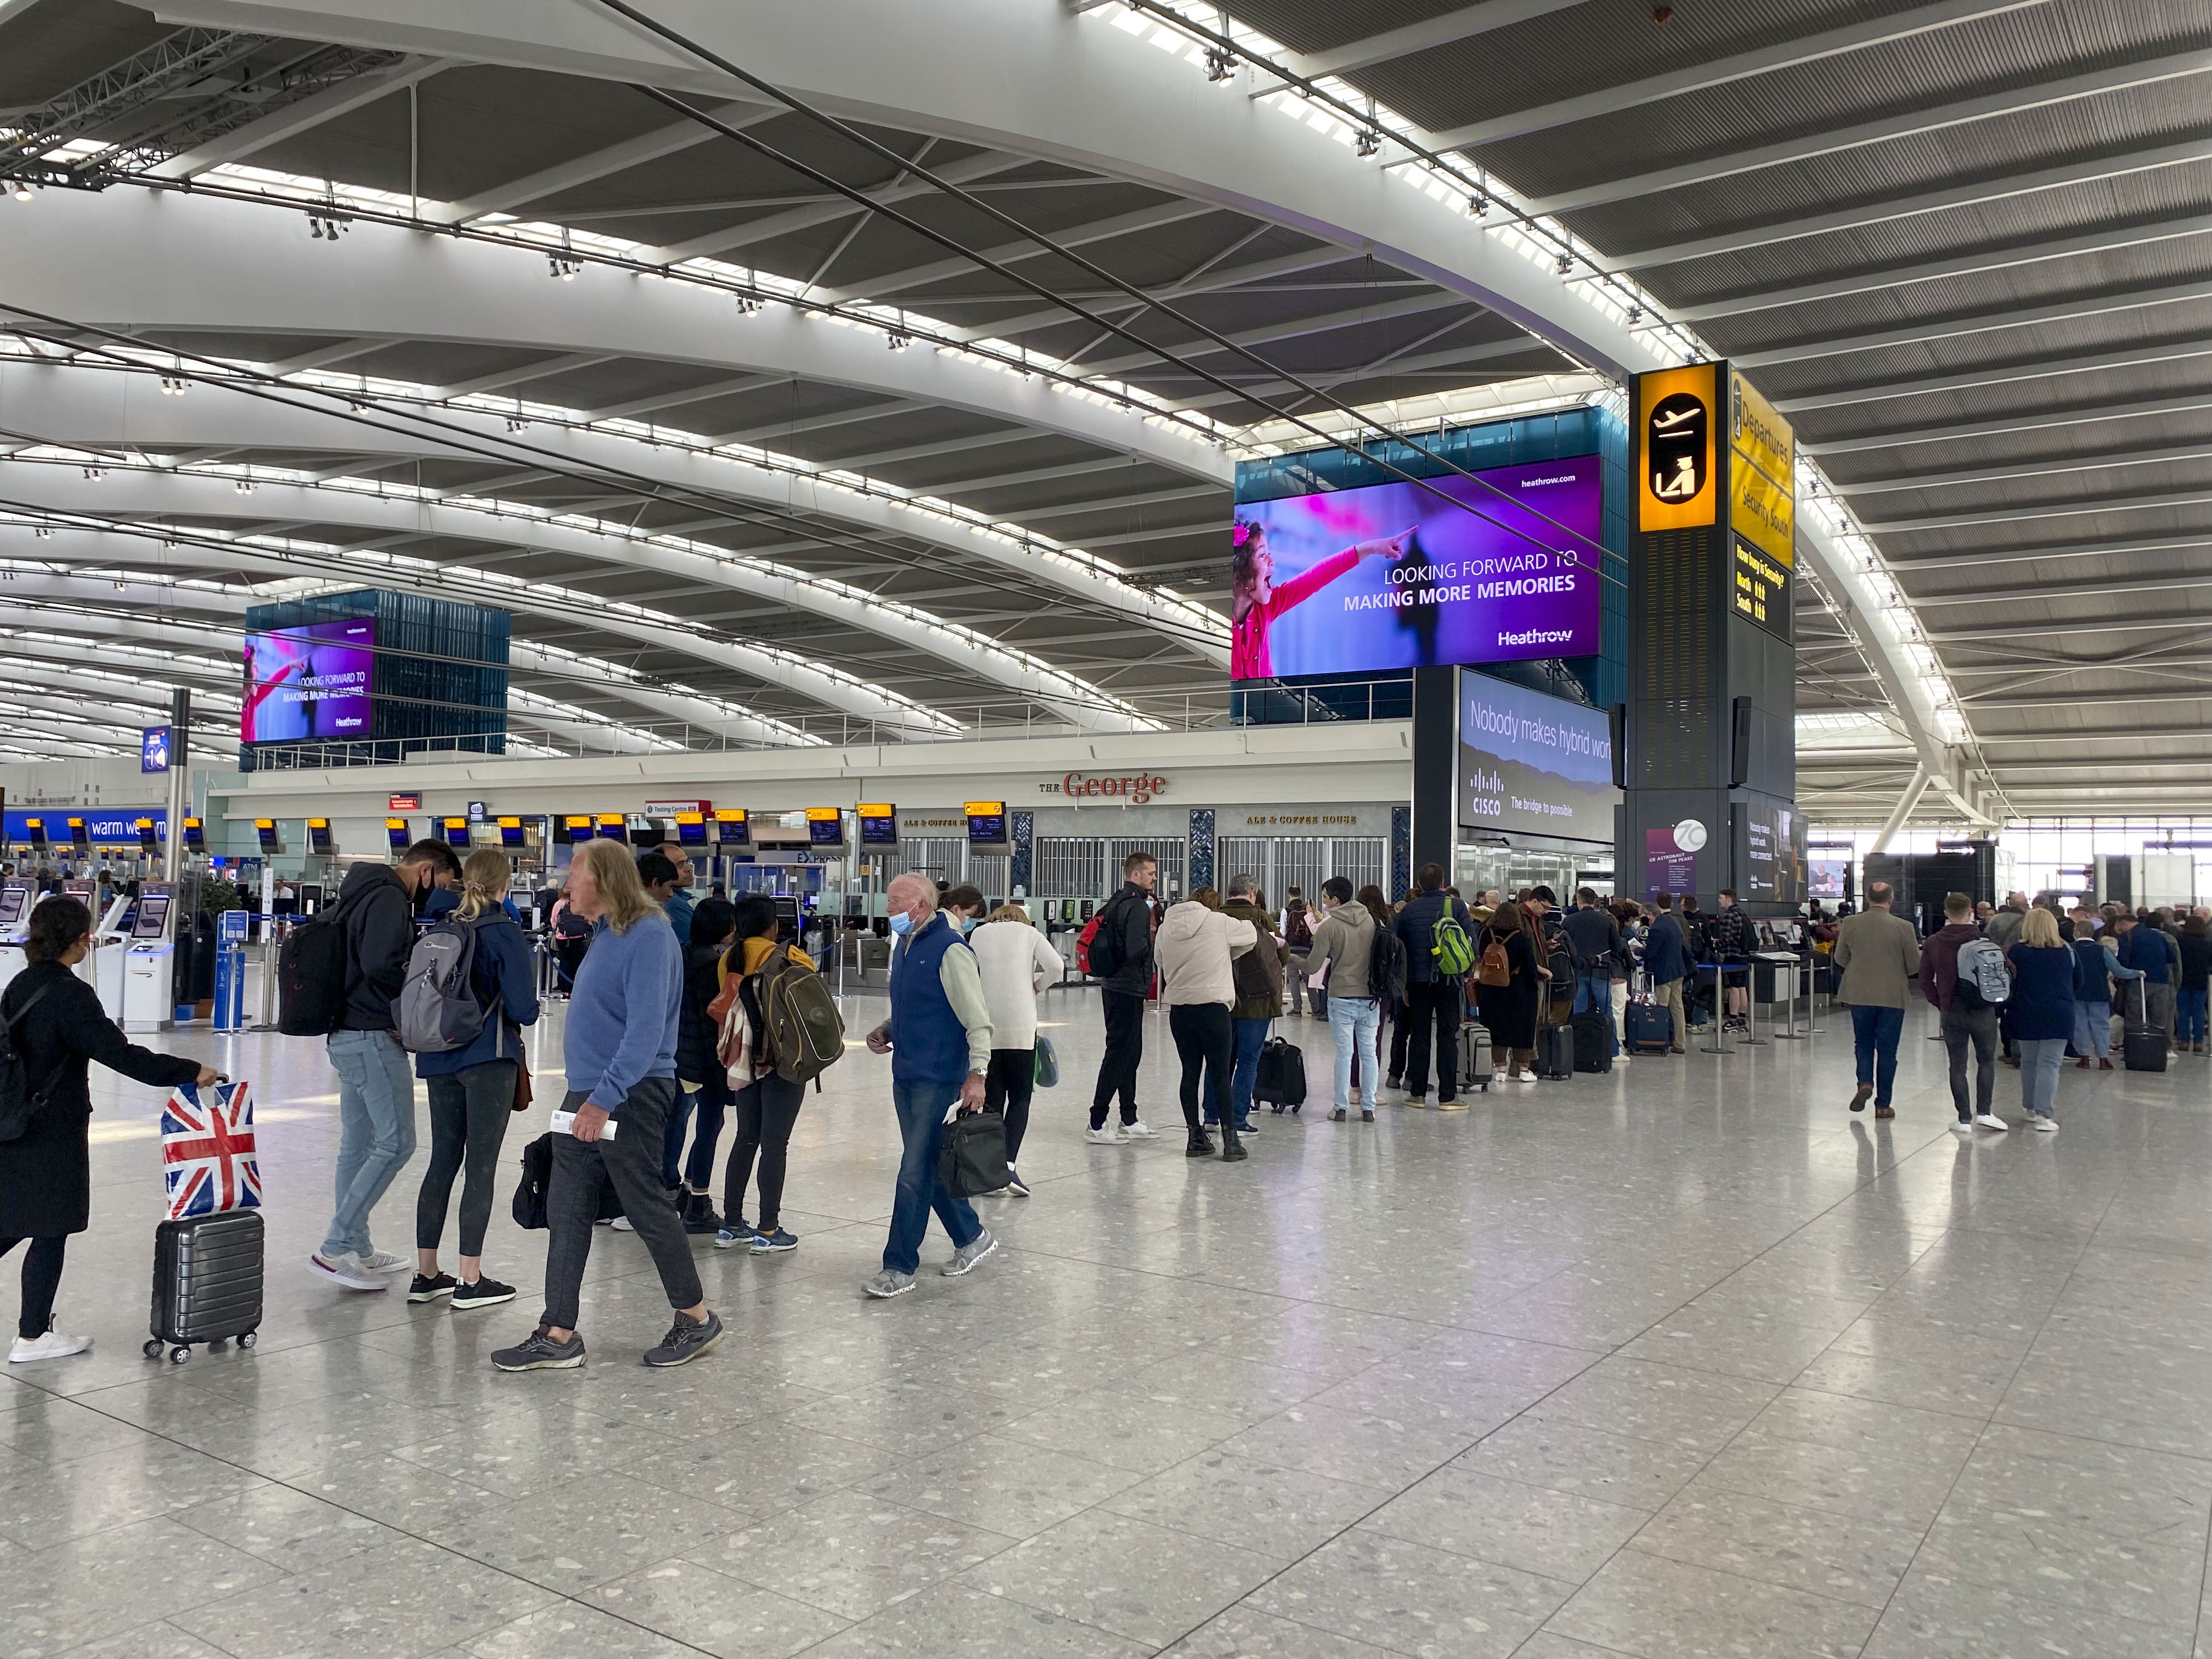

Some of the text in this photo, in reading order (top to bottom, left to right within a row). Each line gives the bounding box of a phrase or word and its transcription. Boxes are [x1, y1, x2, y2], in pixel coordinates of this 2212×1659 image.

[1743, 400, 1788, 466] Departures
[1521, 475, 1576, 488] heathrow.com
[1743, 486, 1788, 539] Security South
[1384, 550, 1578, 585] LOOKING FORWARD TO
[1737, 544, 1748, 564] How
[1748, 551, 1760, 575] busy
[1760, 558, 1765, 575] is
[1737, 571, 1751, 592] North
[1344, 574, 1576, 612] MAKING MORE MEMORIES
[1737, 592, 1751, 613] South
[1498, 628, 1573, 646] Heathrow
[298, 671, 365, 686] LOOKING FORWARD TO
[283, 691, 308, 703] MAKING
[335, 717, 362, 727] Heathrow
[1471, 700, 1519, 743] Nobody
[1521, 717, 1556, 747] makes
[1560, 723, 1589, 755] hybrid
[1039, 772, 1166, 804] THE George
[1511, 795, 1522, 809] The
[1523, 798, 1542, 814] bridge
[1543, 802, 1549, 812] to
[1550, 803, 1573, 817] possible
[92, 821, 123, 836] warm
[1279, 816, 1318, 824] COFFEE
[1322, 815, 1356, 825] HOUSE
[1657, 853, 1685, 861] ASTRONAUT
